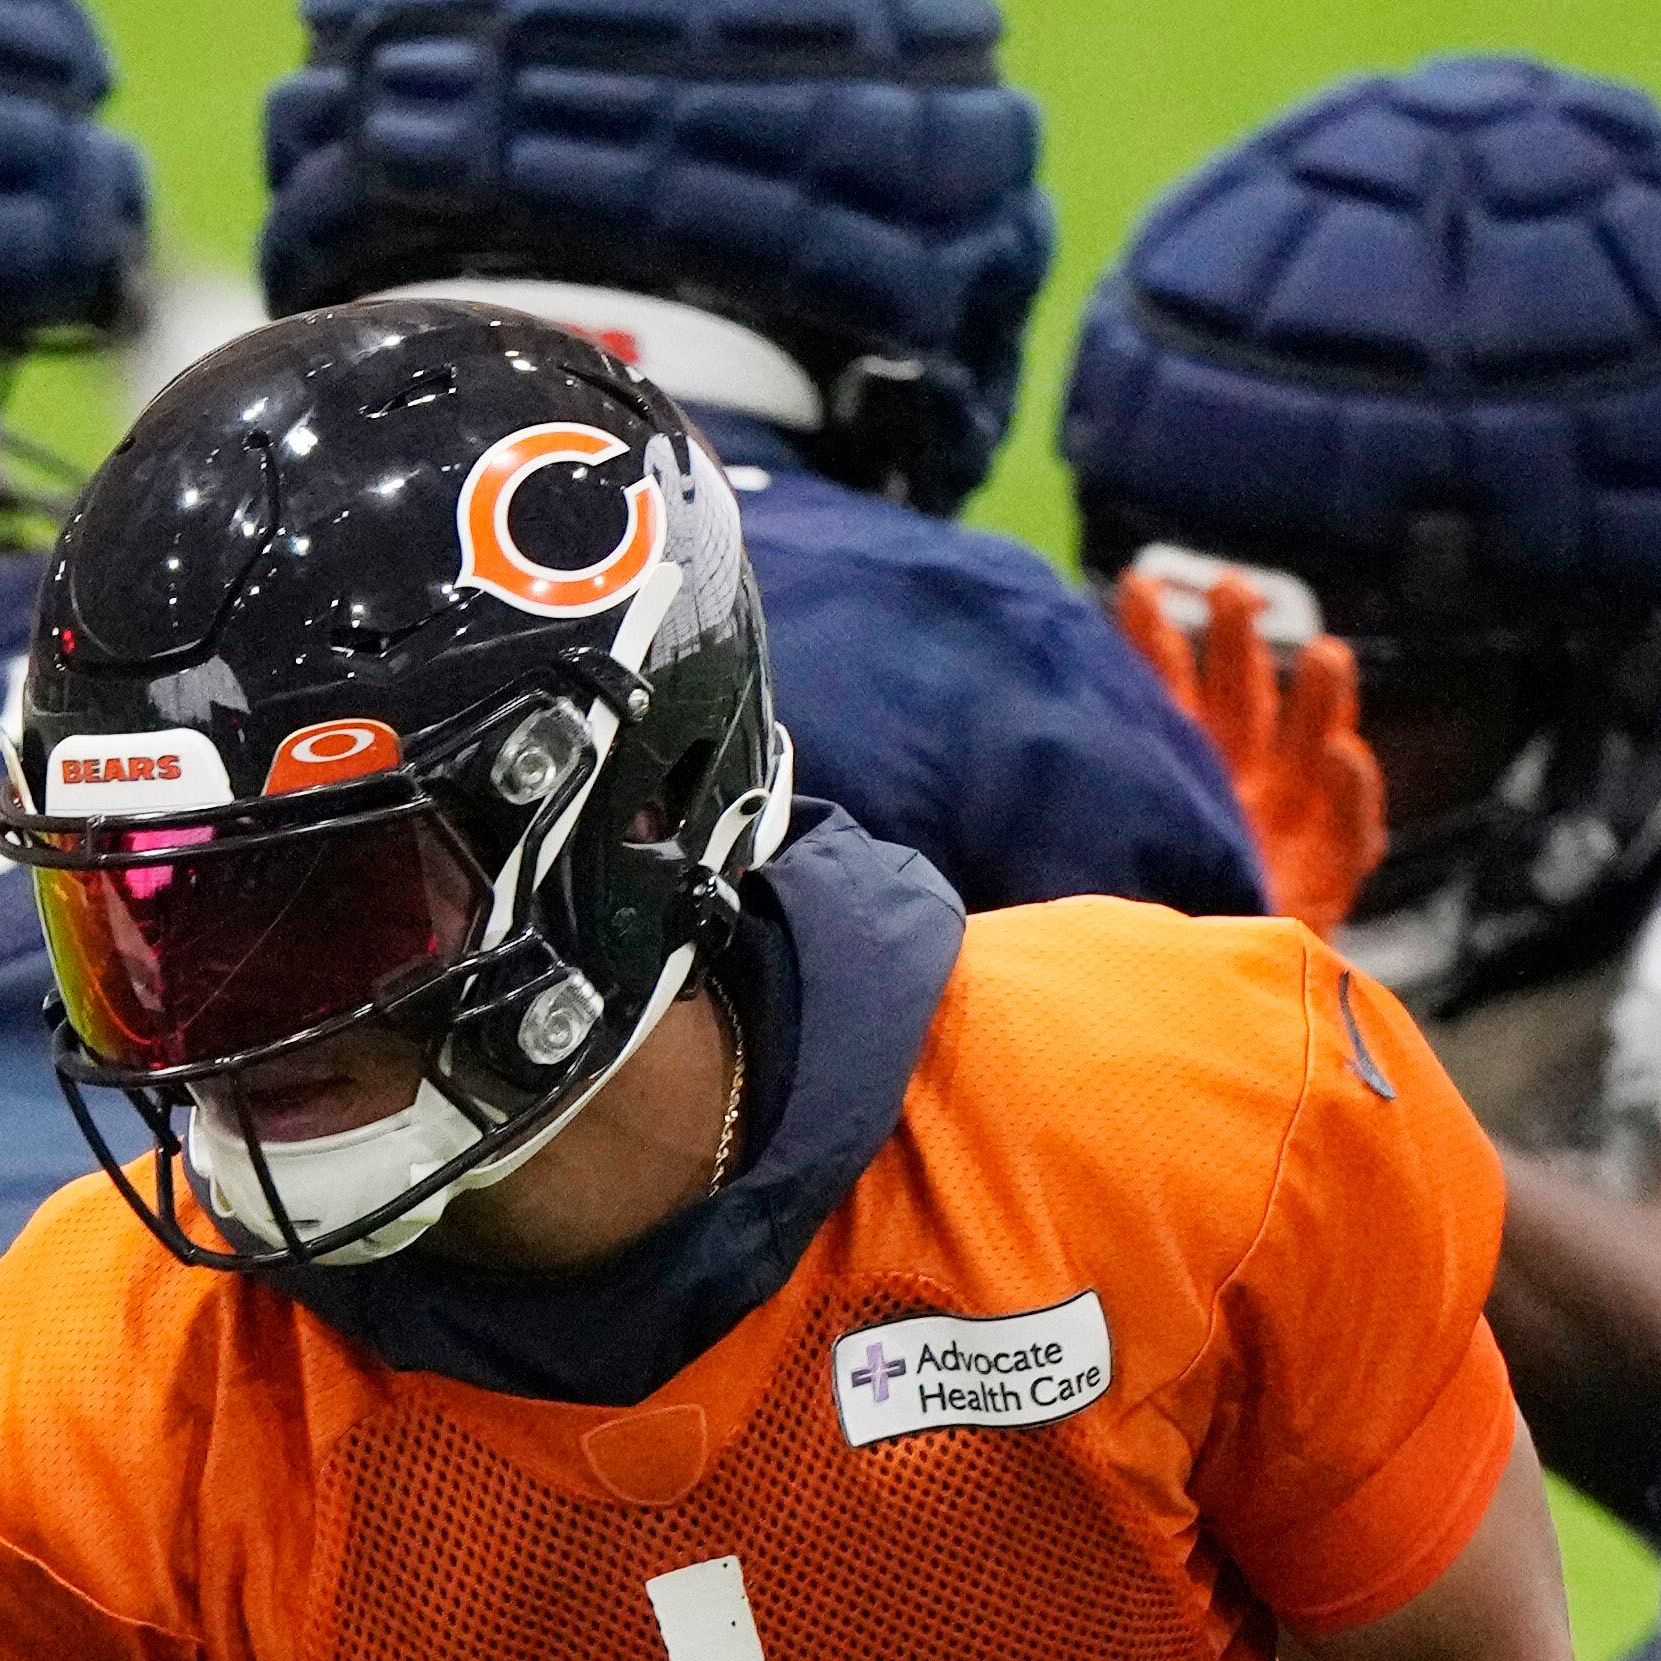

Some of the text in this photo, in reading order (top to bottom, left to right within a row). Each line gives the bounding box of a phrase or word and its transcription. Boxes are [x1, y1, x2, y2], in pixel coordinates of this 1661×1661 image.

[61, 754, 182, 784] BEARS
[916, 1339, 1063, 1375] Advocate
[919, 1364, 1102, 1414] Health Care
